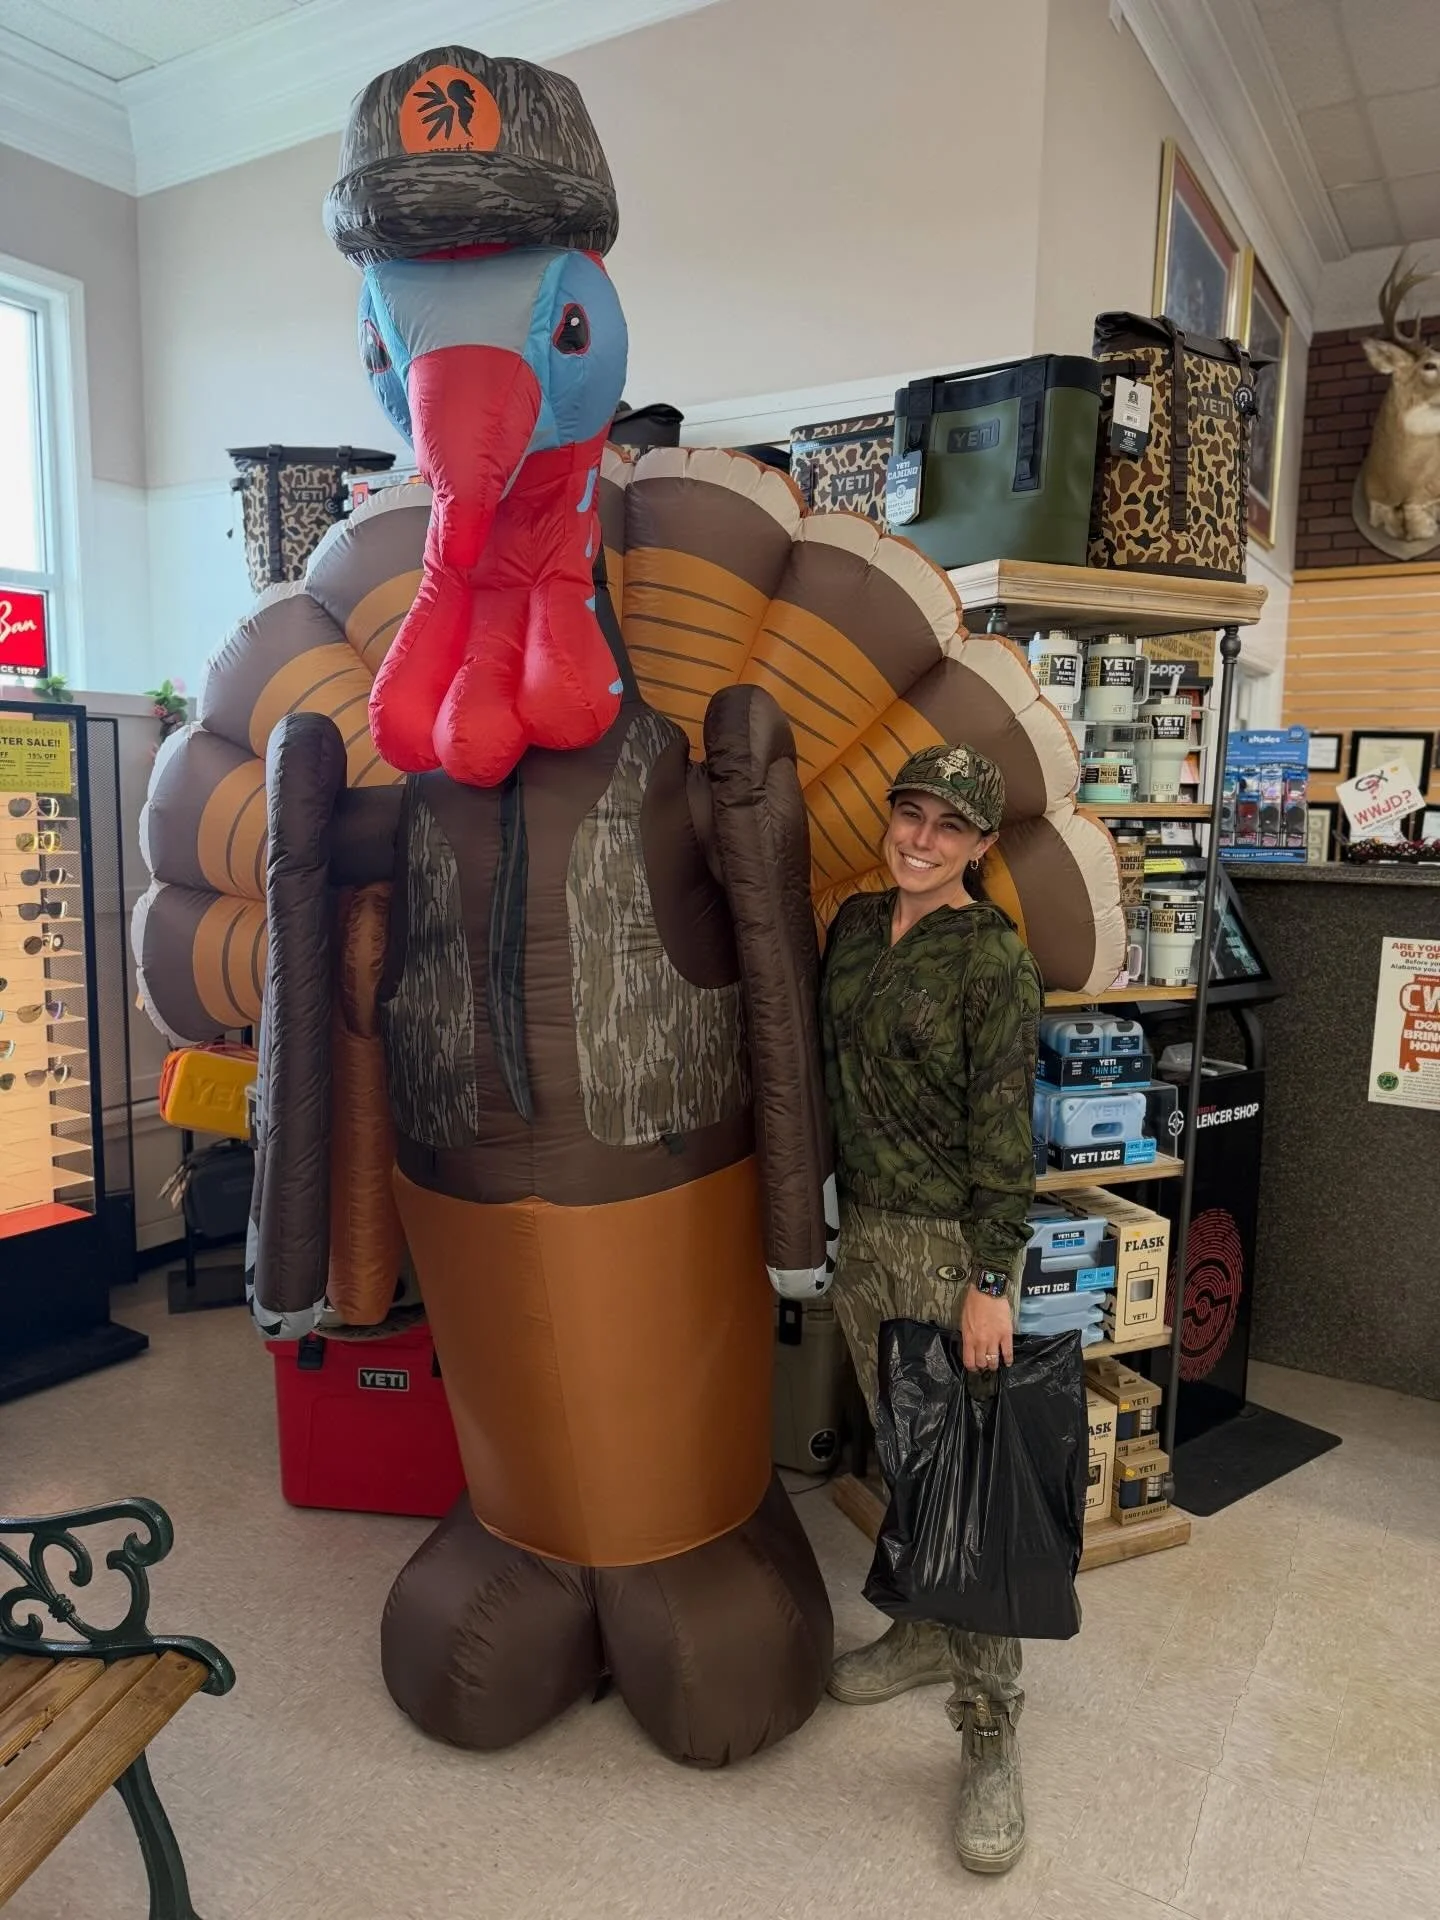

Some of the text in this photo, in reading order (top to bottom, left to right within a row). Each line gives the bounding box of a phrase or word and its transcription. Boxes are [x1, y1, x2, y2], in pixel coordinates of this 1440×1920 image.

[1199, 396, 1230, 417] YETI
[953, 423, 997, 448] YETI
[1123, 430, 1137, 439] YETI
[896, 461, 910, 470] YETI
[887, 467, 918, 481] CAMINO
[835, 474, 870, 492] YETI
[292, 490, 324, 501] YETI
[1053, 657, 1077, 669] YET
[1103, 658, 1134, 671] YETI
[1155, 716, 1184, 727] YETI
[0, 737, 61, 748] TER SALE!!
[1354, 789, 1412, 825] WWJD?
[1391, 942, 1414, 951] ARE
[1399, 950, 1424, 958] OUT
[1390, 963, 1422, 971] Alabama
[1109, 1065, 1124, 1074] ICE
[1092, 1103, 1128, 1119] YETI
[1196, 1102, 1260, 1129] LENCER SHOP
[1070, 1153, 1098, 1165] YETI
[1100, 1149, 1121, 1161] ICE
[1124, 1235, 1165, 1253] FLASK
[1027, 1284, 1051, 1296] YETI
[1052, 1282, 1070, 1292] ICE
[1132, 1312, 1148, 1321] YETI
[361, 1371, 405, 1388] YETI
[1131, 1396, 1149, 1407] YETI
[1088, 1421, 1113, 1436] ASK
[1138, 1463, 1157, 1475] YETI
